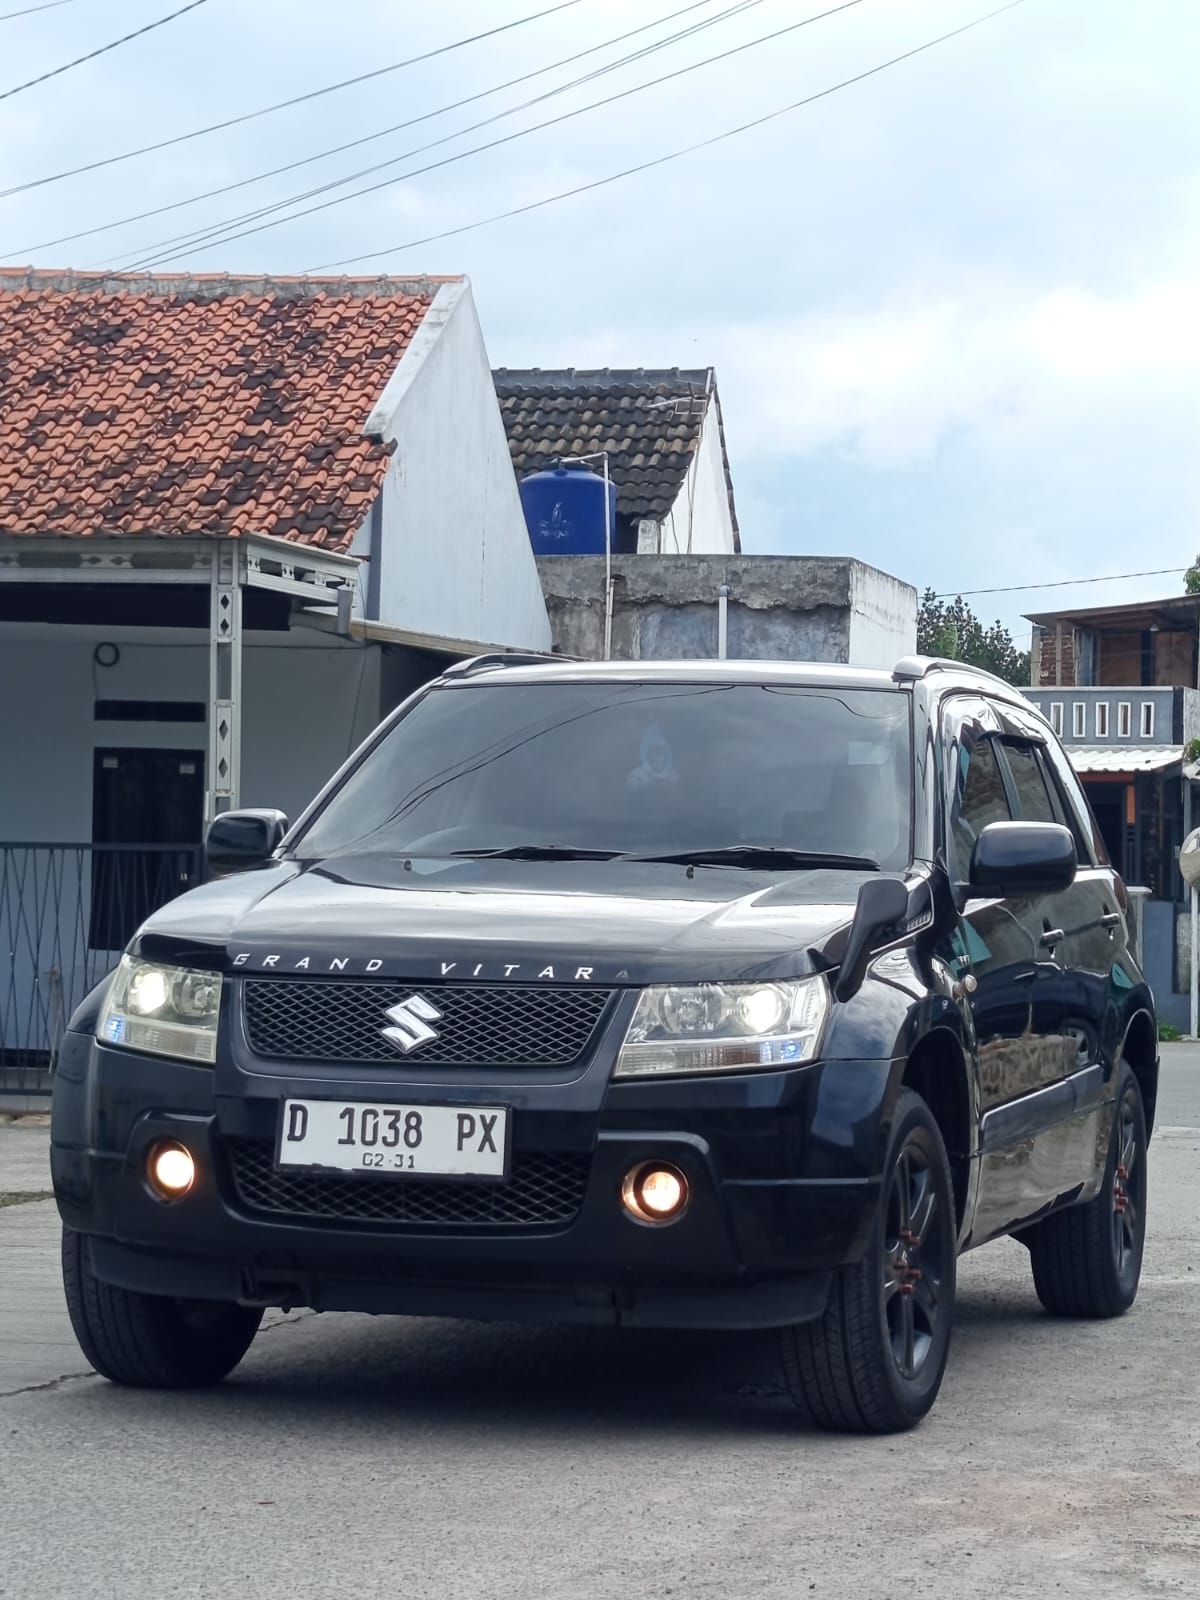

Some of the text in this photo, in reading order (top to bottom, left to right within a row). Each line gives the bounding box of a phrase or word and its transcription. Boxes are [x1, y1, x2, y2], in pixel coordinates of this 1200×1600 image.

[233, 953, 631, 981] GRAND VITARA
[287, 1104, 498, 1153] D 1038 PX
